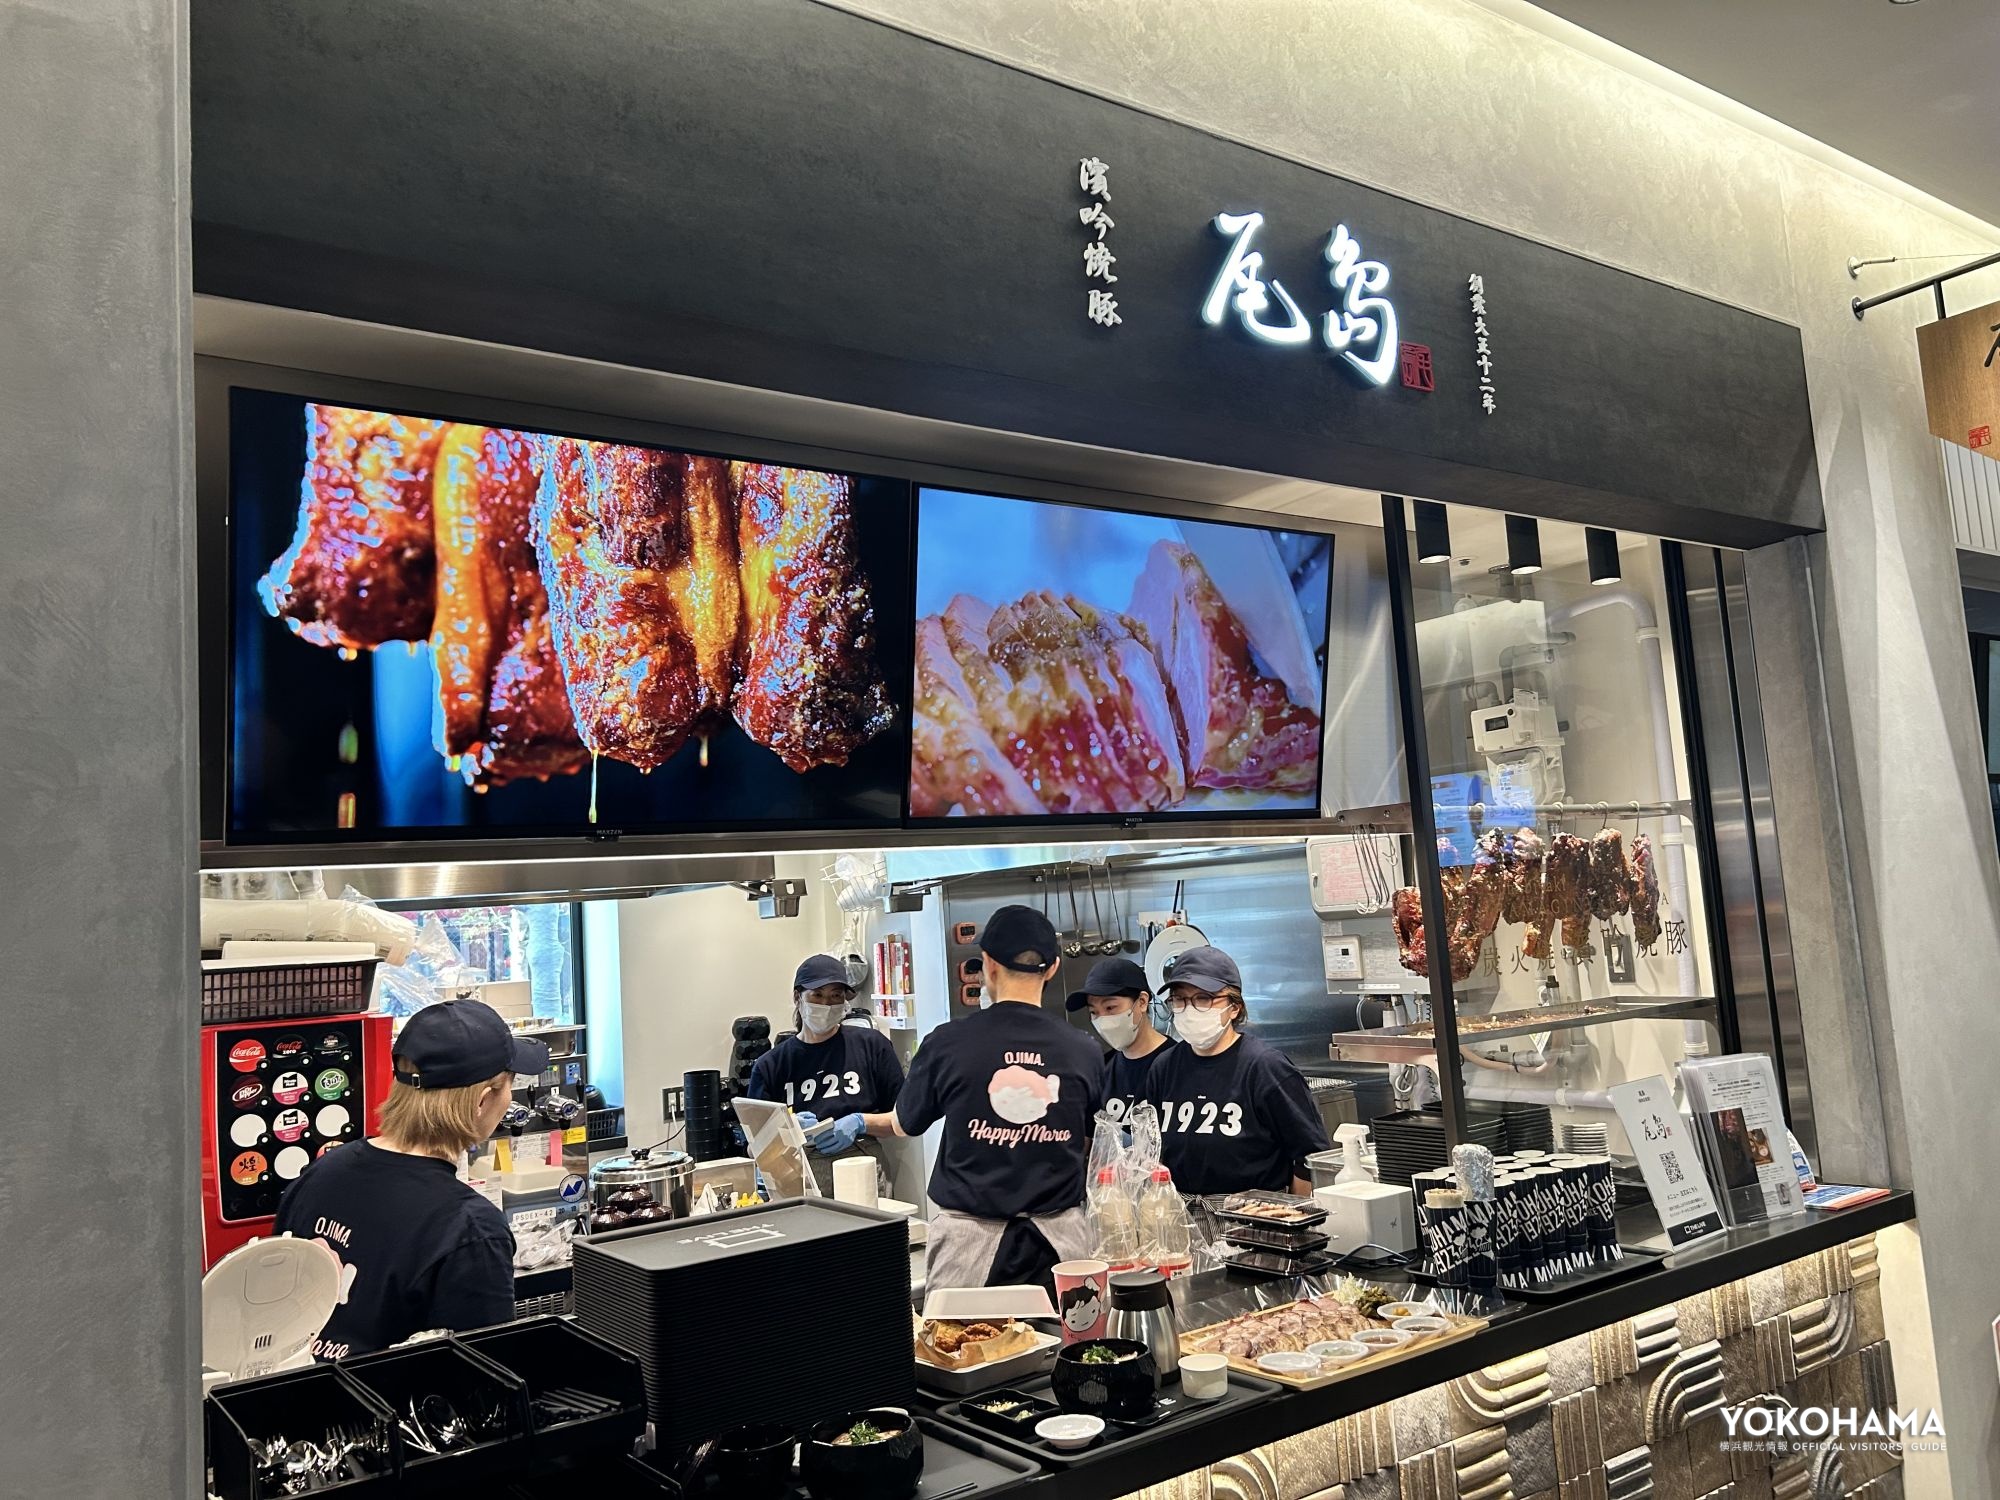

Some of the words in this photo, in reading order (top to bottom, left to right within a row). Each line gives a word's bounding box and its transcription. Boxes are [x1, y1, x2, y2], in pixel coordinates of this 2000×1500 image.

[784, 1071, 861, 1106] 1923
[968, 1119, 1023, 1149] Happy
[1160, 1101, 1243, 1137] 1923
[314, 1216, 352, 1249] OJIMA.
[310, 1338, 349, 1359] arco
